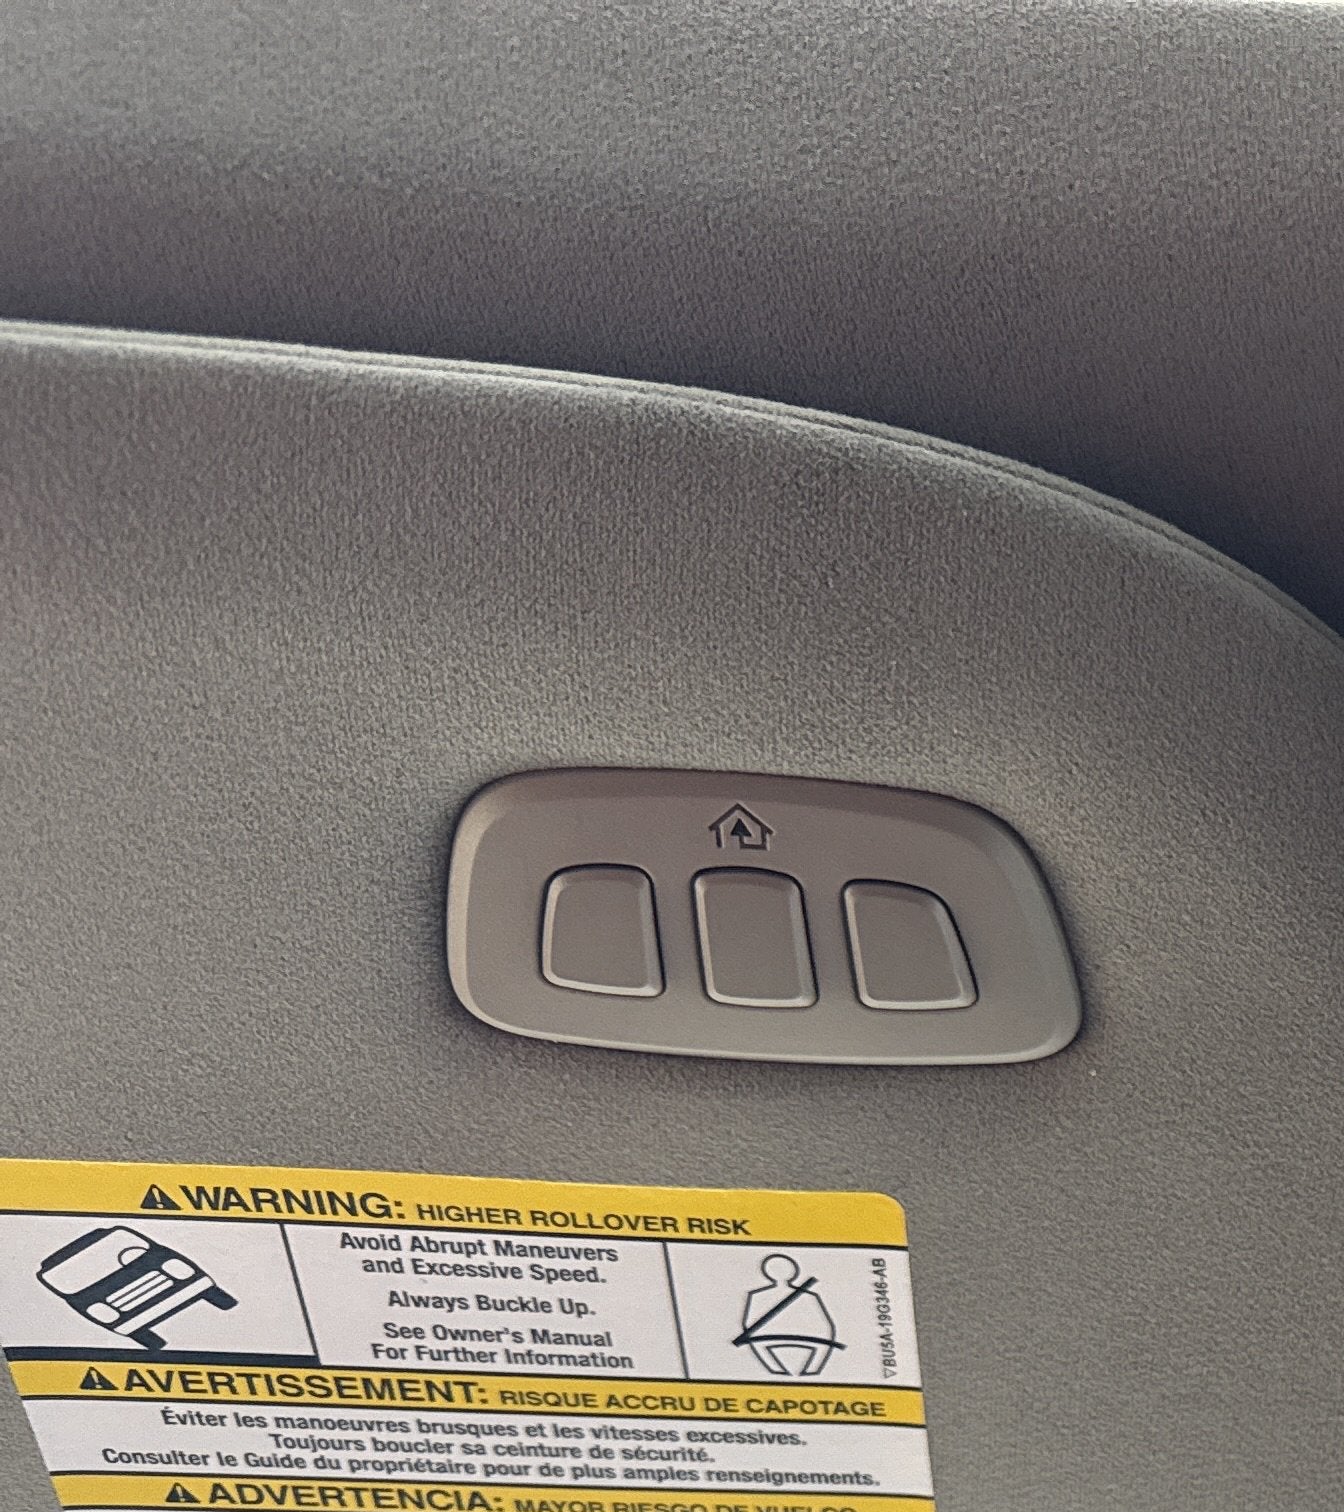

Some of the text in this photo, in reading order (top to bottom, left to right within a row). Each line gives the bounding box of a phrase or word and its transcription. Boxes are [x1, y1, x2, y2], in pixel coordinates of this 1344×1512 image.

[179, 1185, 751, 1235] WARNING: HIGHER ROLLOVER RISK
[340, 1231, 619, 1261] Avoid Abrupt Maneuvers
[362, 1258, 607, 1285] and Excessive Speed.
[388, 1291, 595, 1318] Always Buckle Up.
[384, 1322, 612, 1347] See Owner's Manual
[371, 1344, 634, 1369] For Further Information
[124, 1369, 886, 1418] AVERTISSEMENT: RISQUE ACCRU DE CAPOTAGE
[160, 1406, 807, 1446] Éviter les manoeuvres brusques et les vitesses excessives.
[269, 1433, 715, 1463] Toujours boucler sa ceinture de sécurité.
[102, 1449, 880, 1486] Consulter le Guide du propriétaire pour de plus amples renseignements.
[208, 1483, 505, 1512] ADVERTENCIA:
